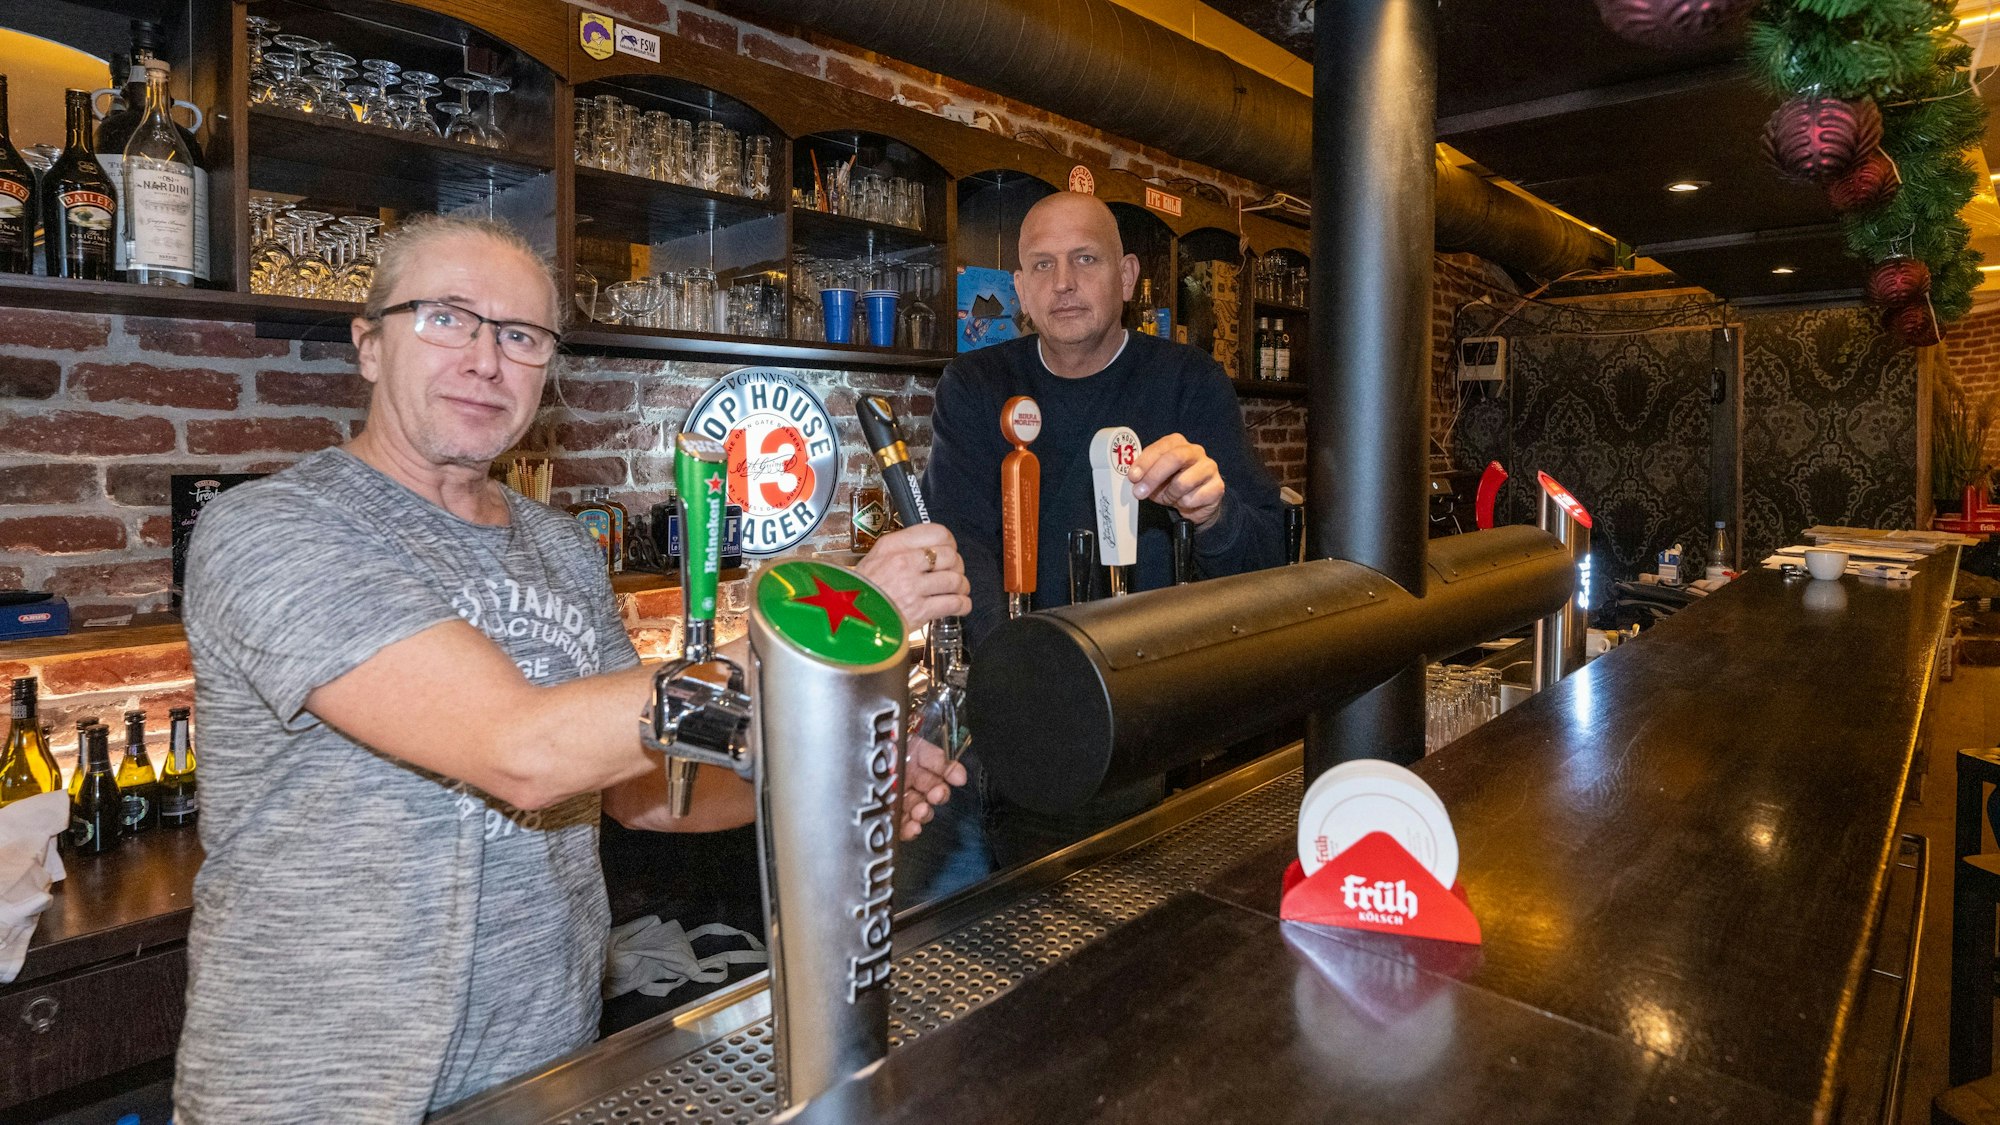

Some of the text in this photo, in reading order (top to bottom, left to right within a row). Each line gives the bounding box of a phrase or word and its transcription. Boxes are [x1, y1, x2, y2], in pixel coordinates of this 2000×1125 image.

[641, 38, 656, 53] FSW
[1, 181, 26, 197] EYS
[143, 180, 190, 197] NARDINI
[65, 192, 114, 211] BAILEYS
[70, 232, 111, 243] ORIGINAL
[737, 372, 796, 389] GUINNESS
[703, 383, 831, 457] OP HOUSE
[754, 419, 775, 427] GATE
[1116, 444, 1135, 466] 13
[723, 425, 816, 512] 13
[907, 474, 932, 524] UINNESS
[728, 520, 737, 542] F
[742, 501, 816, 545] AGER
[704, 498, 721, 574] Heineken
[848, 700, 901, 1005] Heineken
[1339, 874, 1419, 920] früh
[1358, 911, 1404, 926] KÖLSCH
